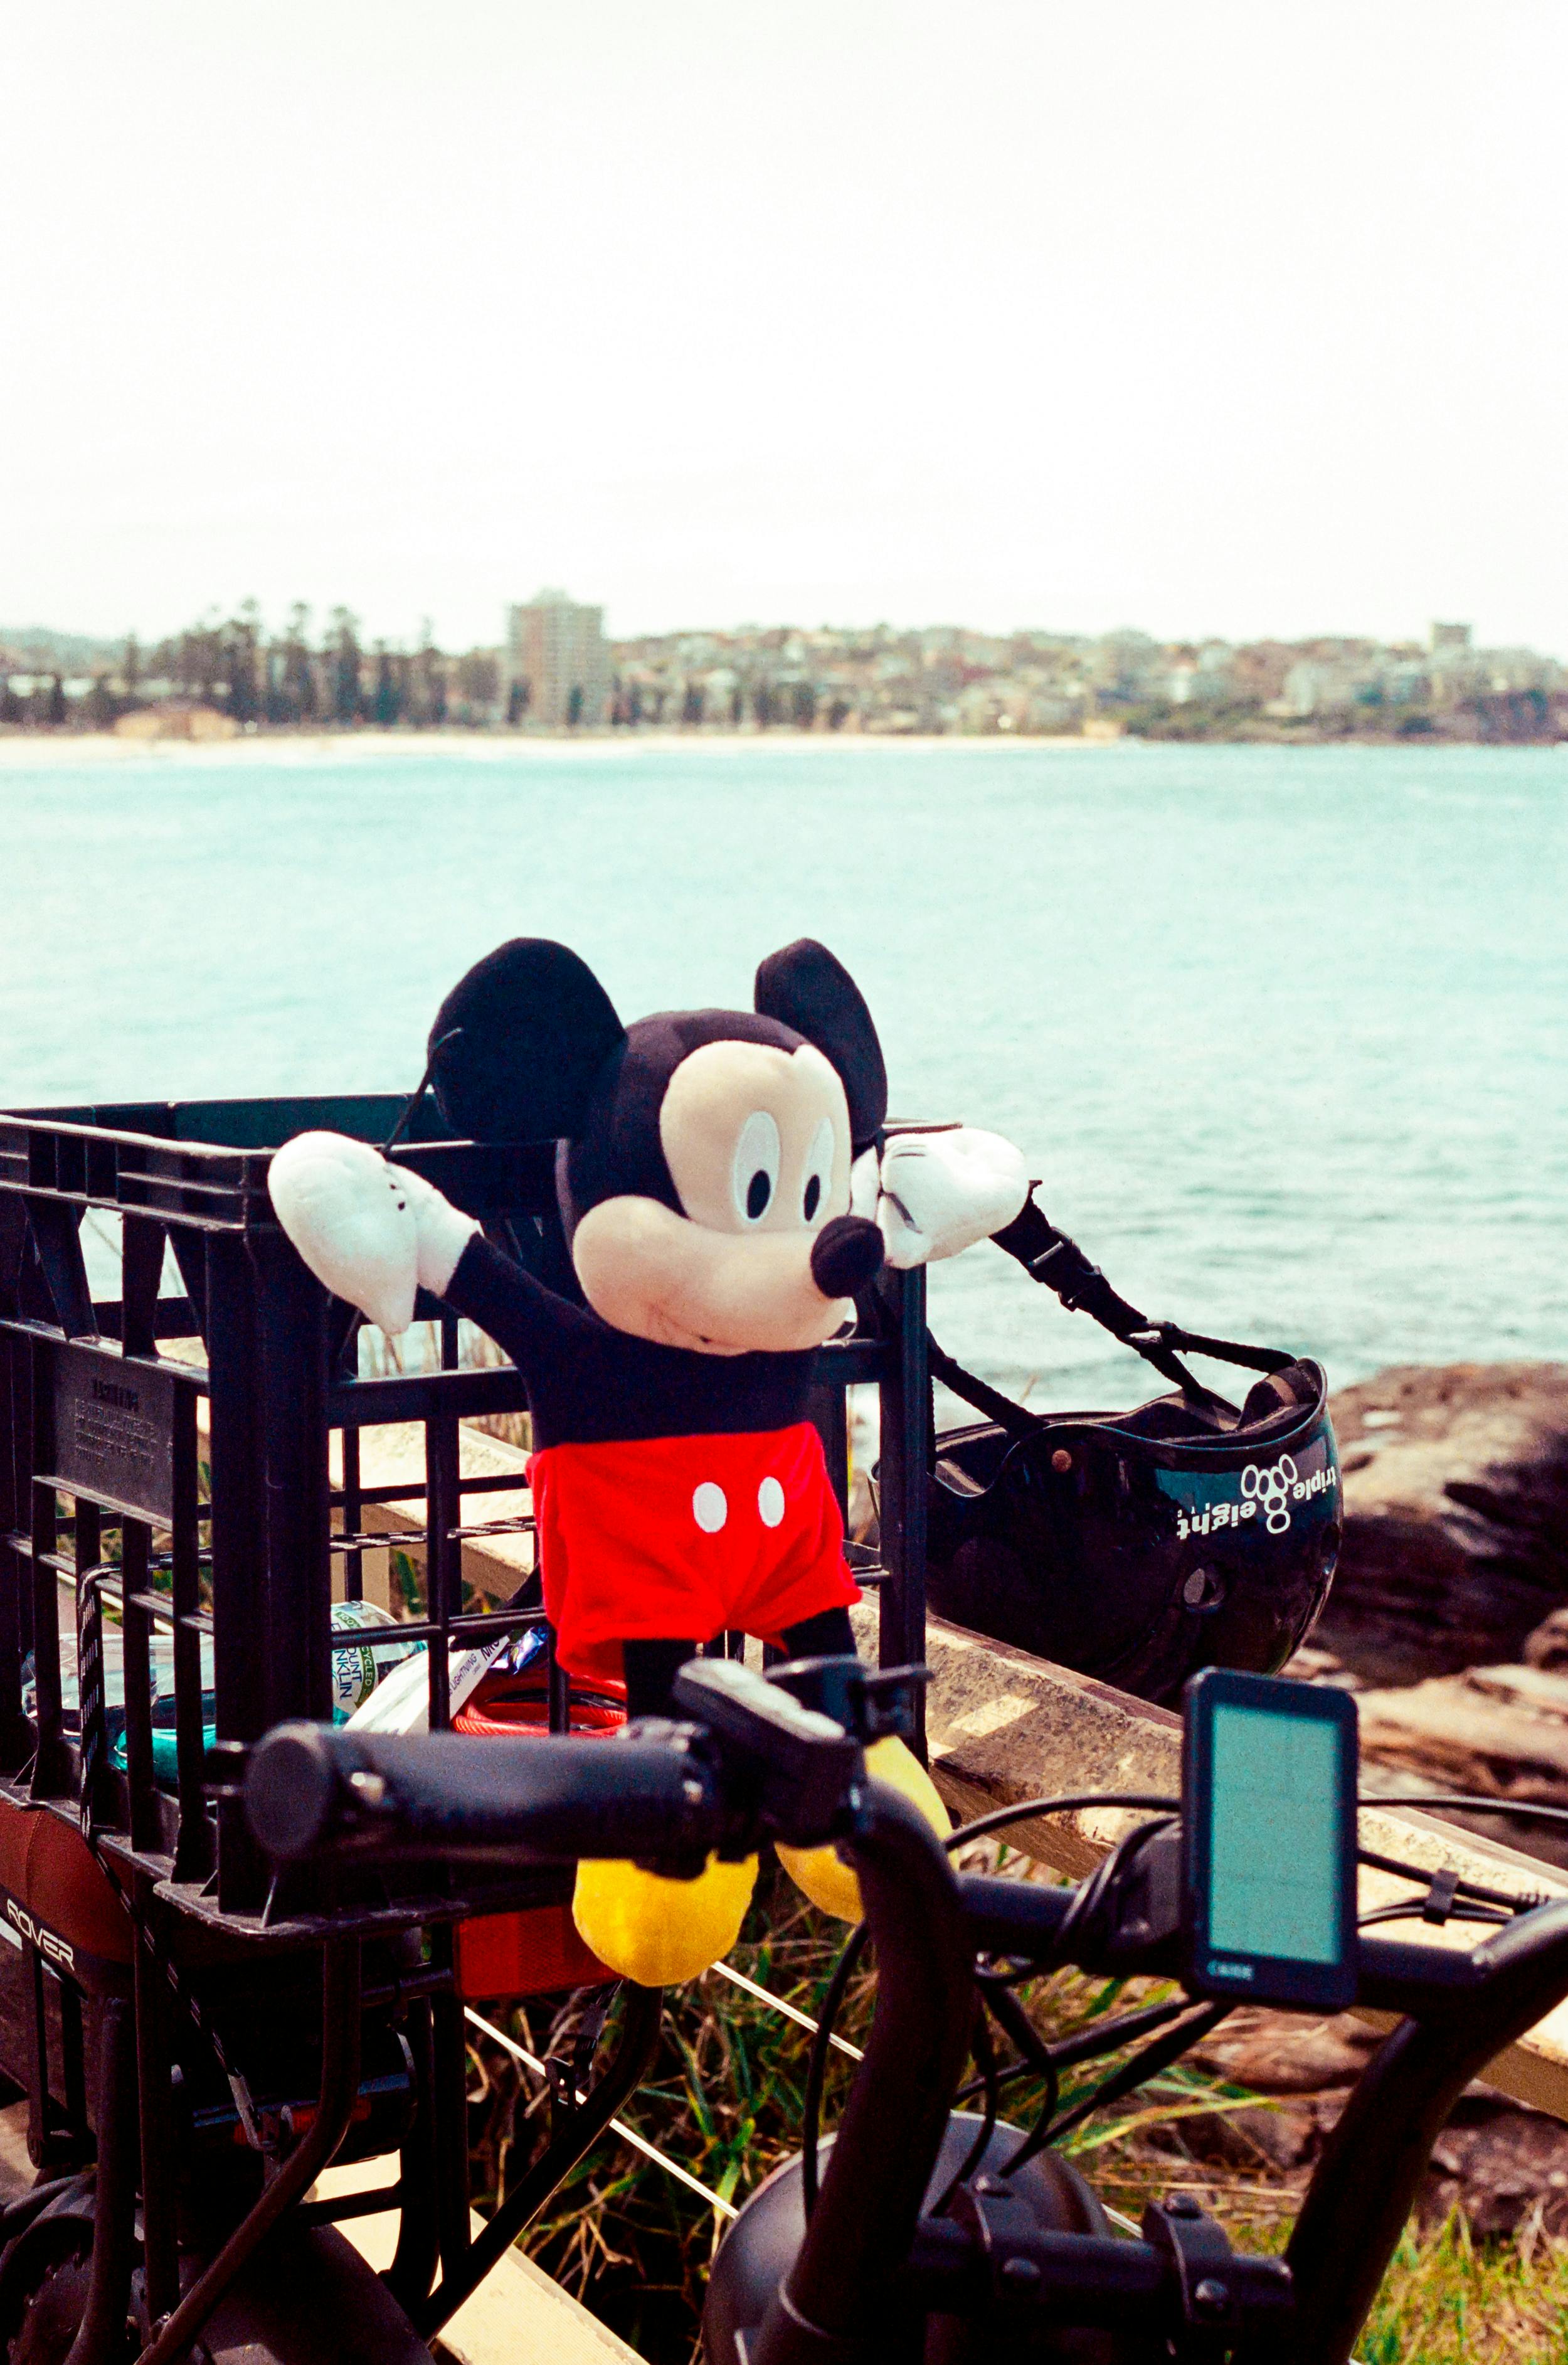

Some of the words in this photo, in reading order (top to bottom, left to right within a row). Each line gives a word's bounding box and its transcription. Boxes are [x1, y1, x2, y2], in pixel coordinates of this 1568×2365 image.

[1293, 1466, 1336, 1501] triple
[1177, 1501, 1257, 1540] eight
[346, 1647, 363, 1682] OUNT
[449, 1653, 477, 1691] LIGHTNING
[7, 1898, 75, 1971] ROVER
